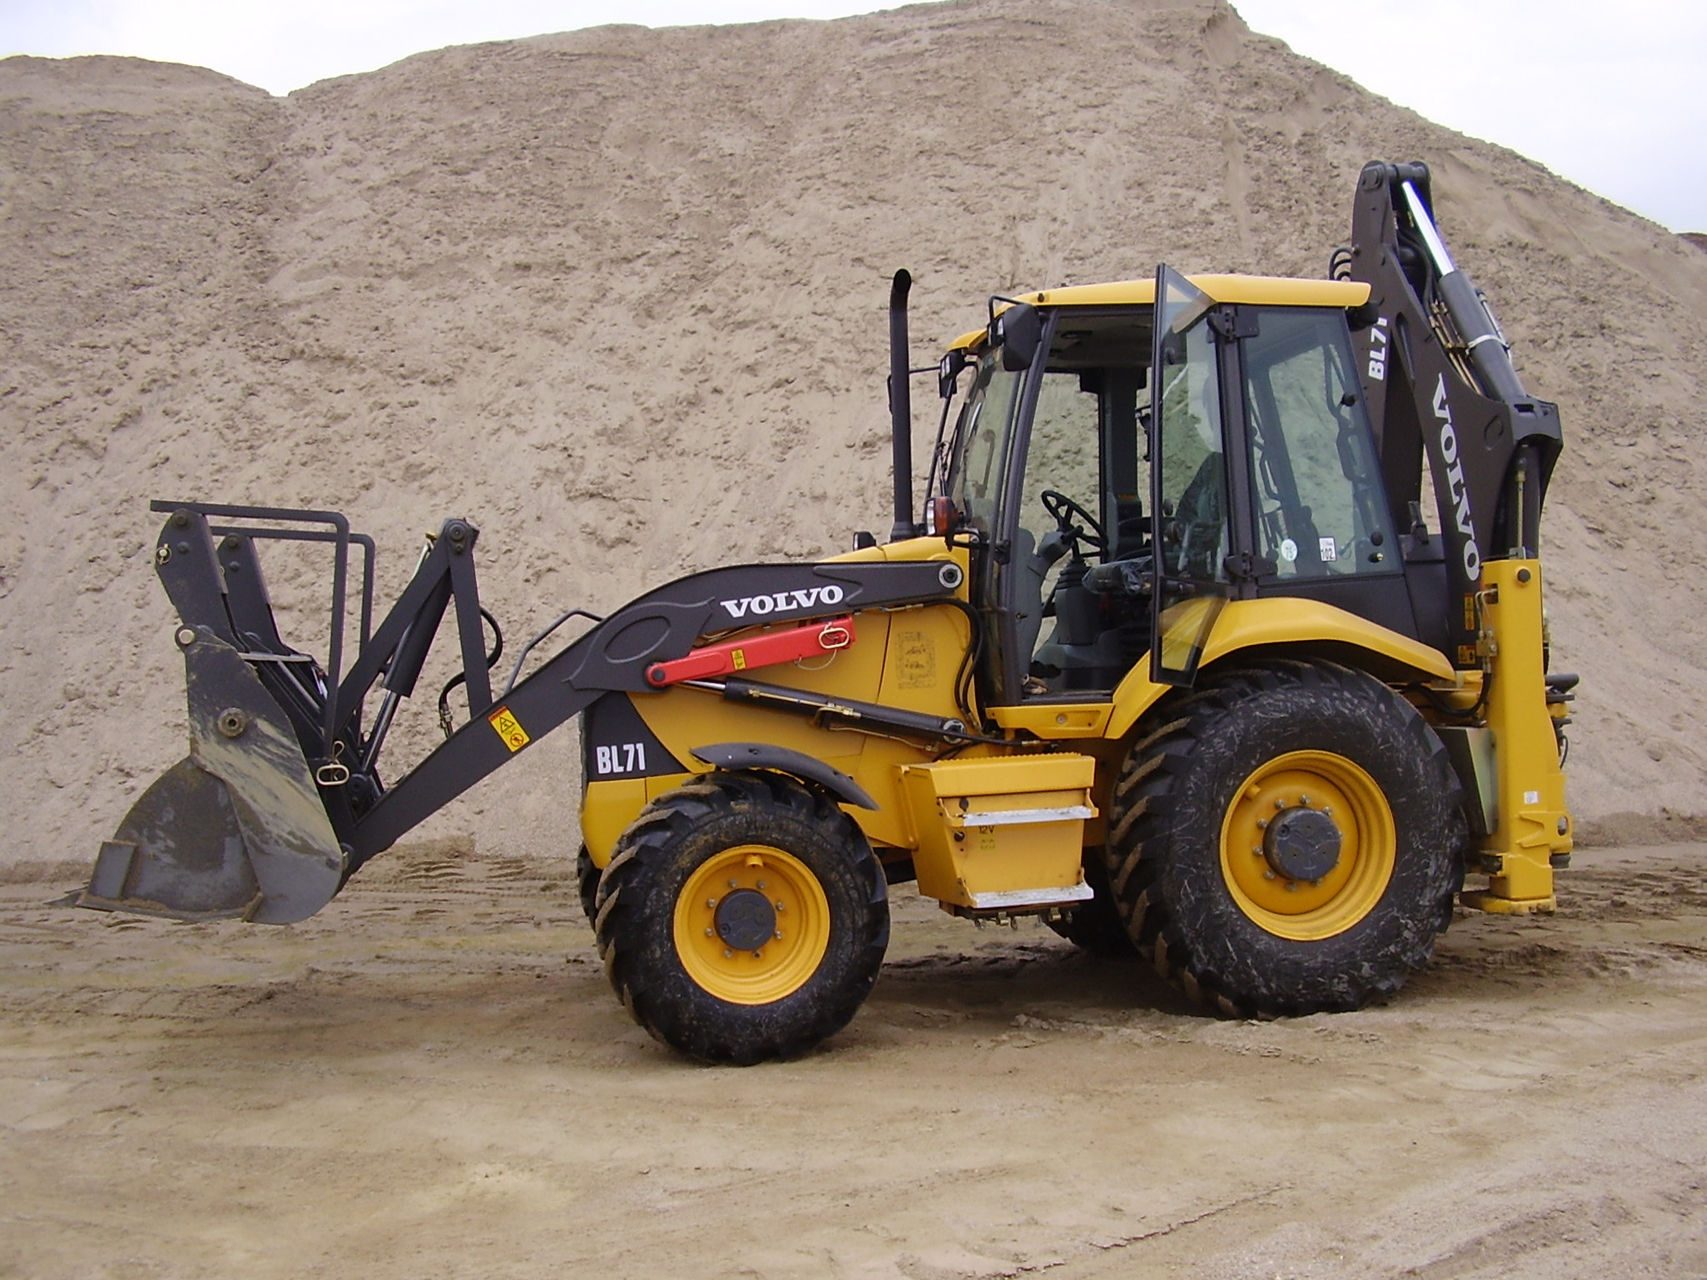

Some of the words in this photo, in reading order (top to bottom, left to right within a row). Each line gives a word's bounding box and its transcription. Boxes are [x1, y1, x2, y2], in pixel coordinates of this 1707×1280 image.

[1432, 373, 1480, 581] VOLVO
[720, 585, 844, 618] VOLVO
[596, 742, 646, 775] BL71
